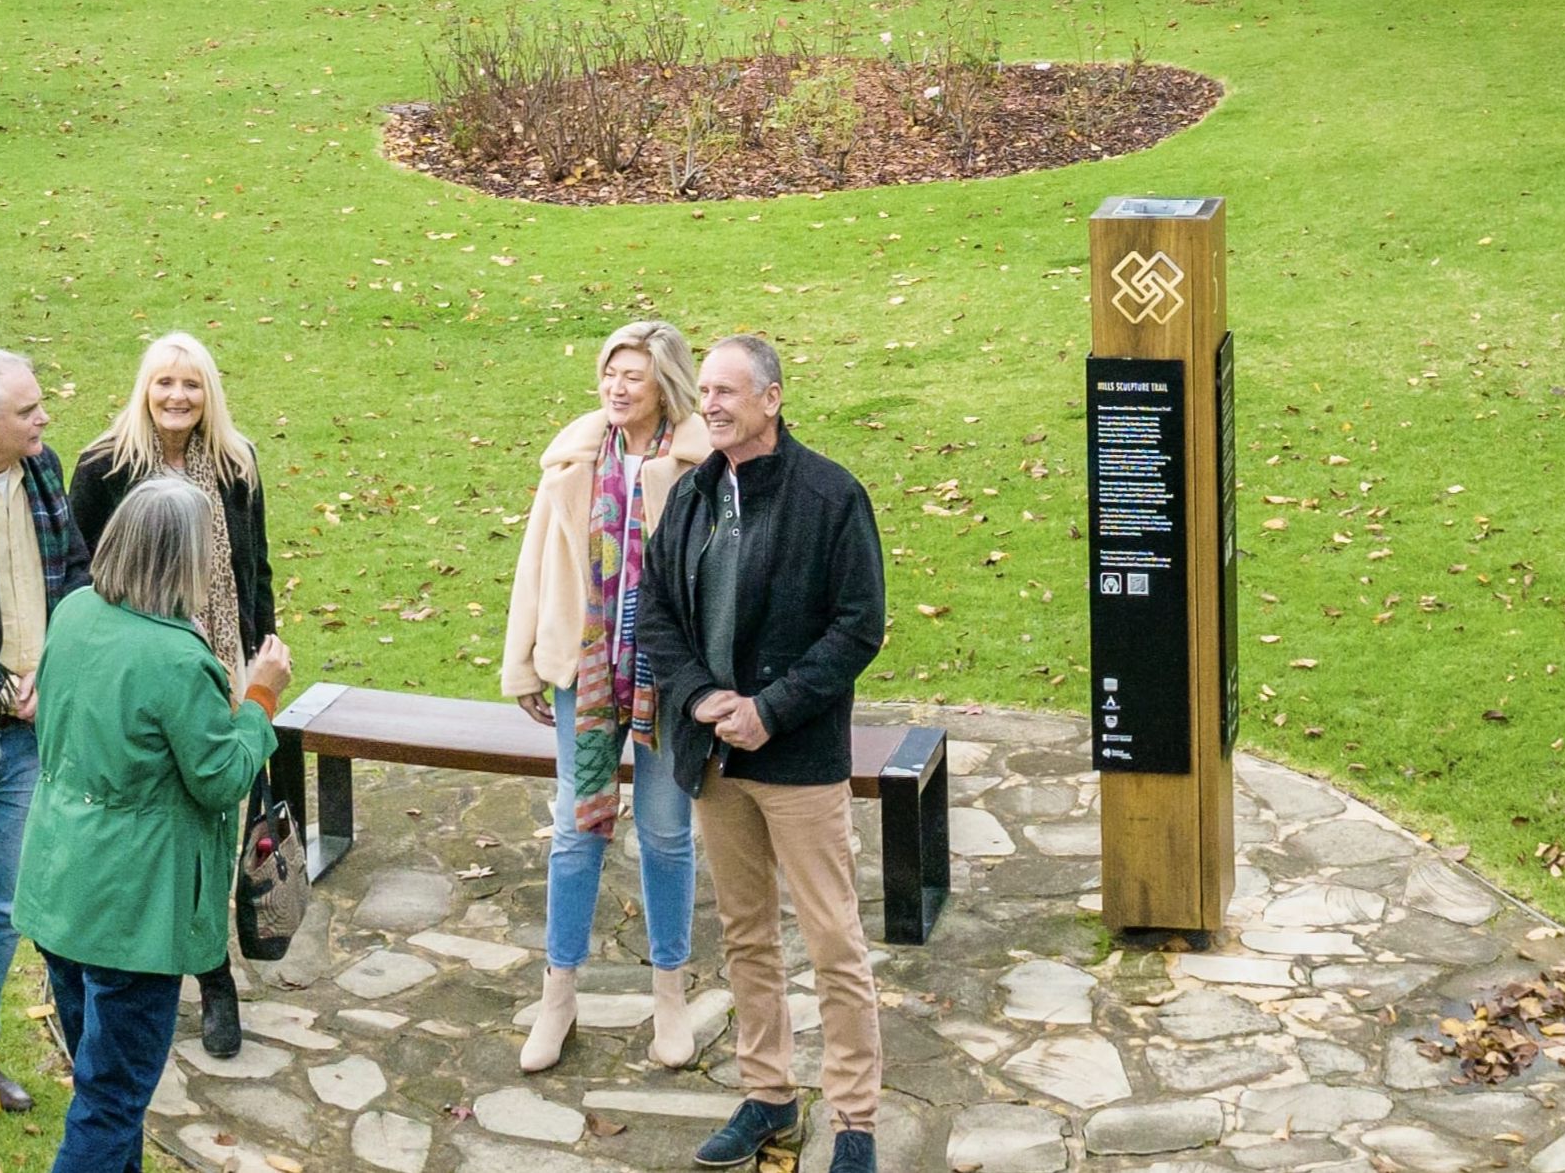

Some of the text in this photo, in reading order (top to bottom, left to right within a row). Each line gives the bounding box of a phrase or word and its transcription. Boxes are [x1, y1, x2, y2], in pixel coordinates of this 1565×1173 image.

[1097, 382, 1168, 392] HILLS SCULPTURE TRAIL
